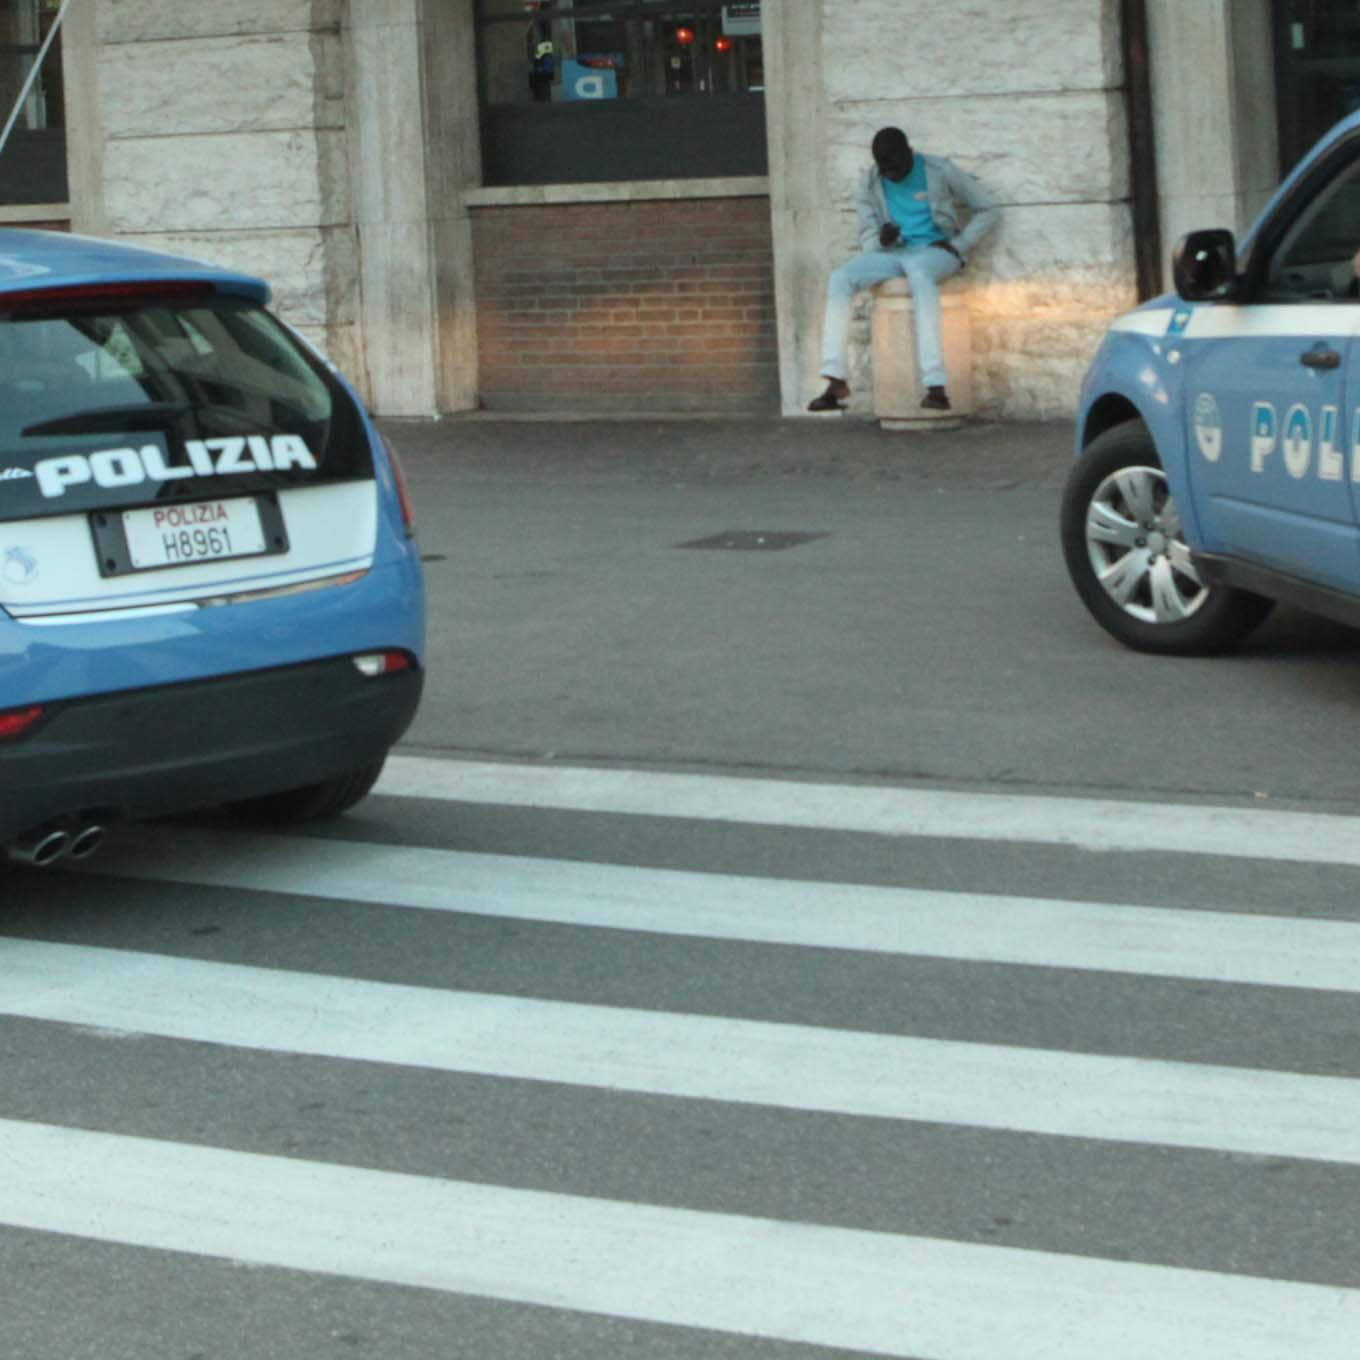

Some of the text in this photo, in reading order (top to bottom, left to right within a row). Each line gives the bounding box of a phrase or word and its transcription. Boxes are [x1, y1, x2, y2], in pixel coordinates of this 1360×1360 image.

[34, 434, 317, 499] POLIZIA
[153, 503, 229, 528] POLIZIA
[161, 526, 232, 560] H8961
